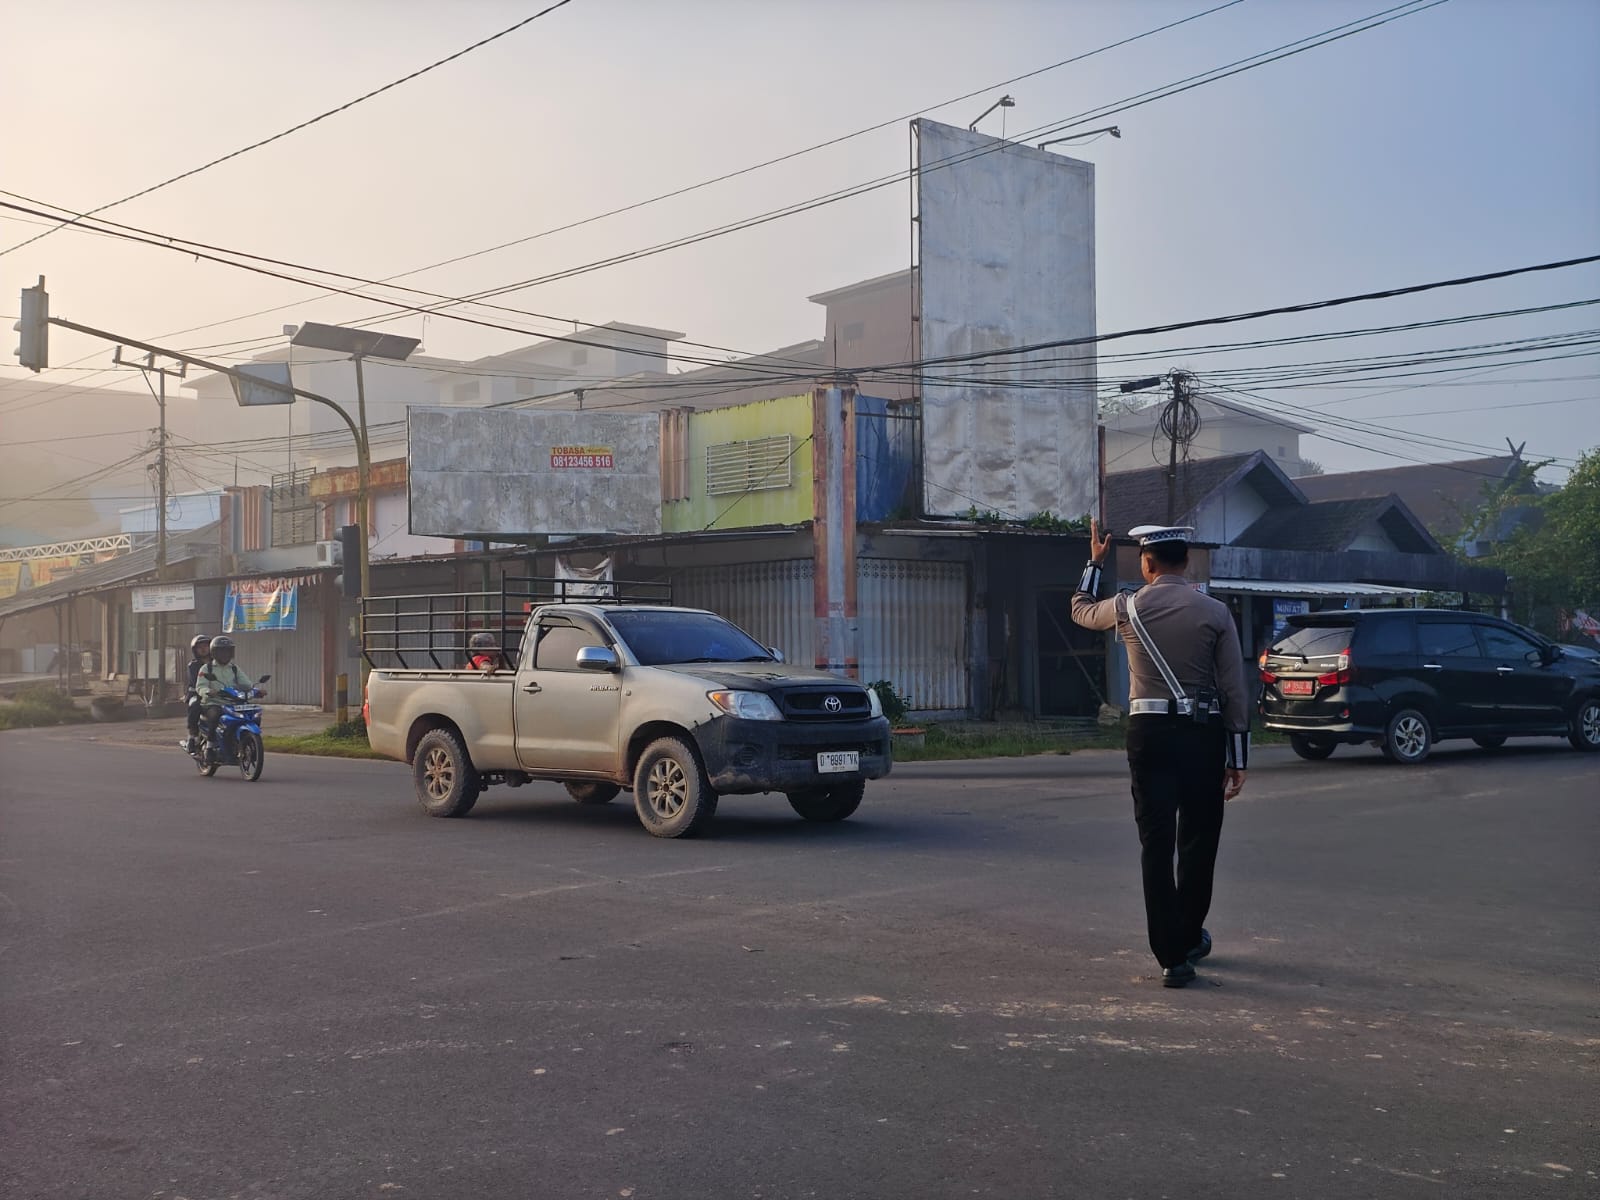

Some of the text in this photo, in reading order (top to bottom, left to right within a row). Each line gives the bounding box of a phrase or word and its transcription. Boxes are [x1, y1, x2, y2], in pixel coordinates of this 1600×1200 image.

[551, 446, 585, 455] TOBASA
[552, 456, 611, 467] 08123456 516
[830, 754, 846, 766] 8991
